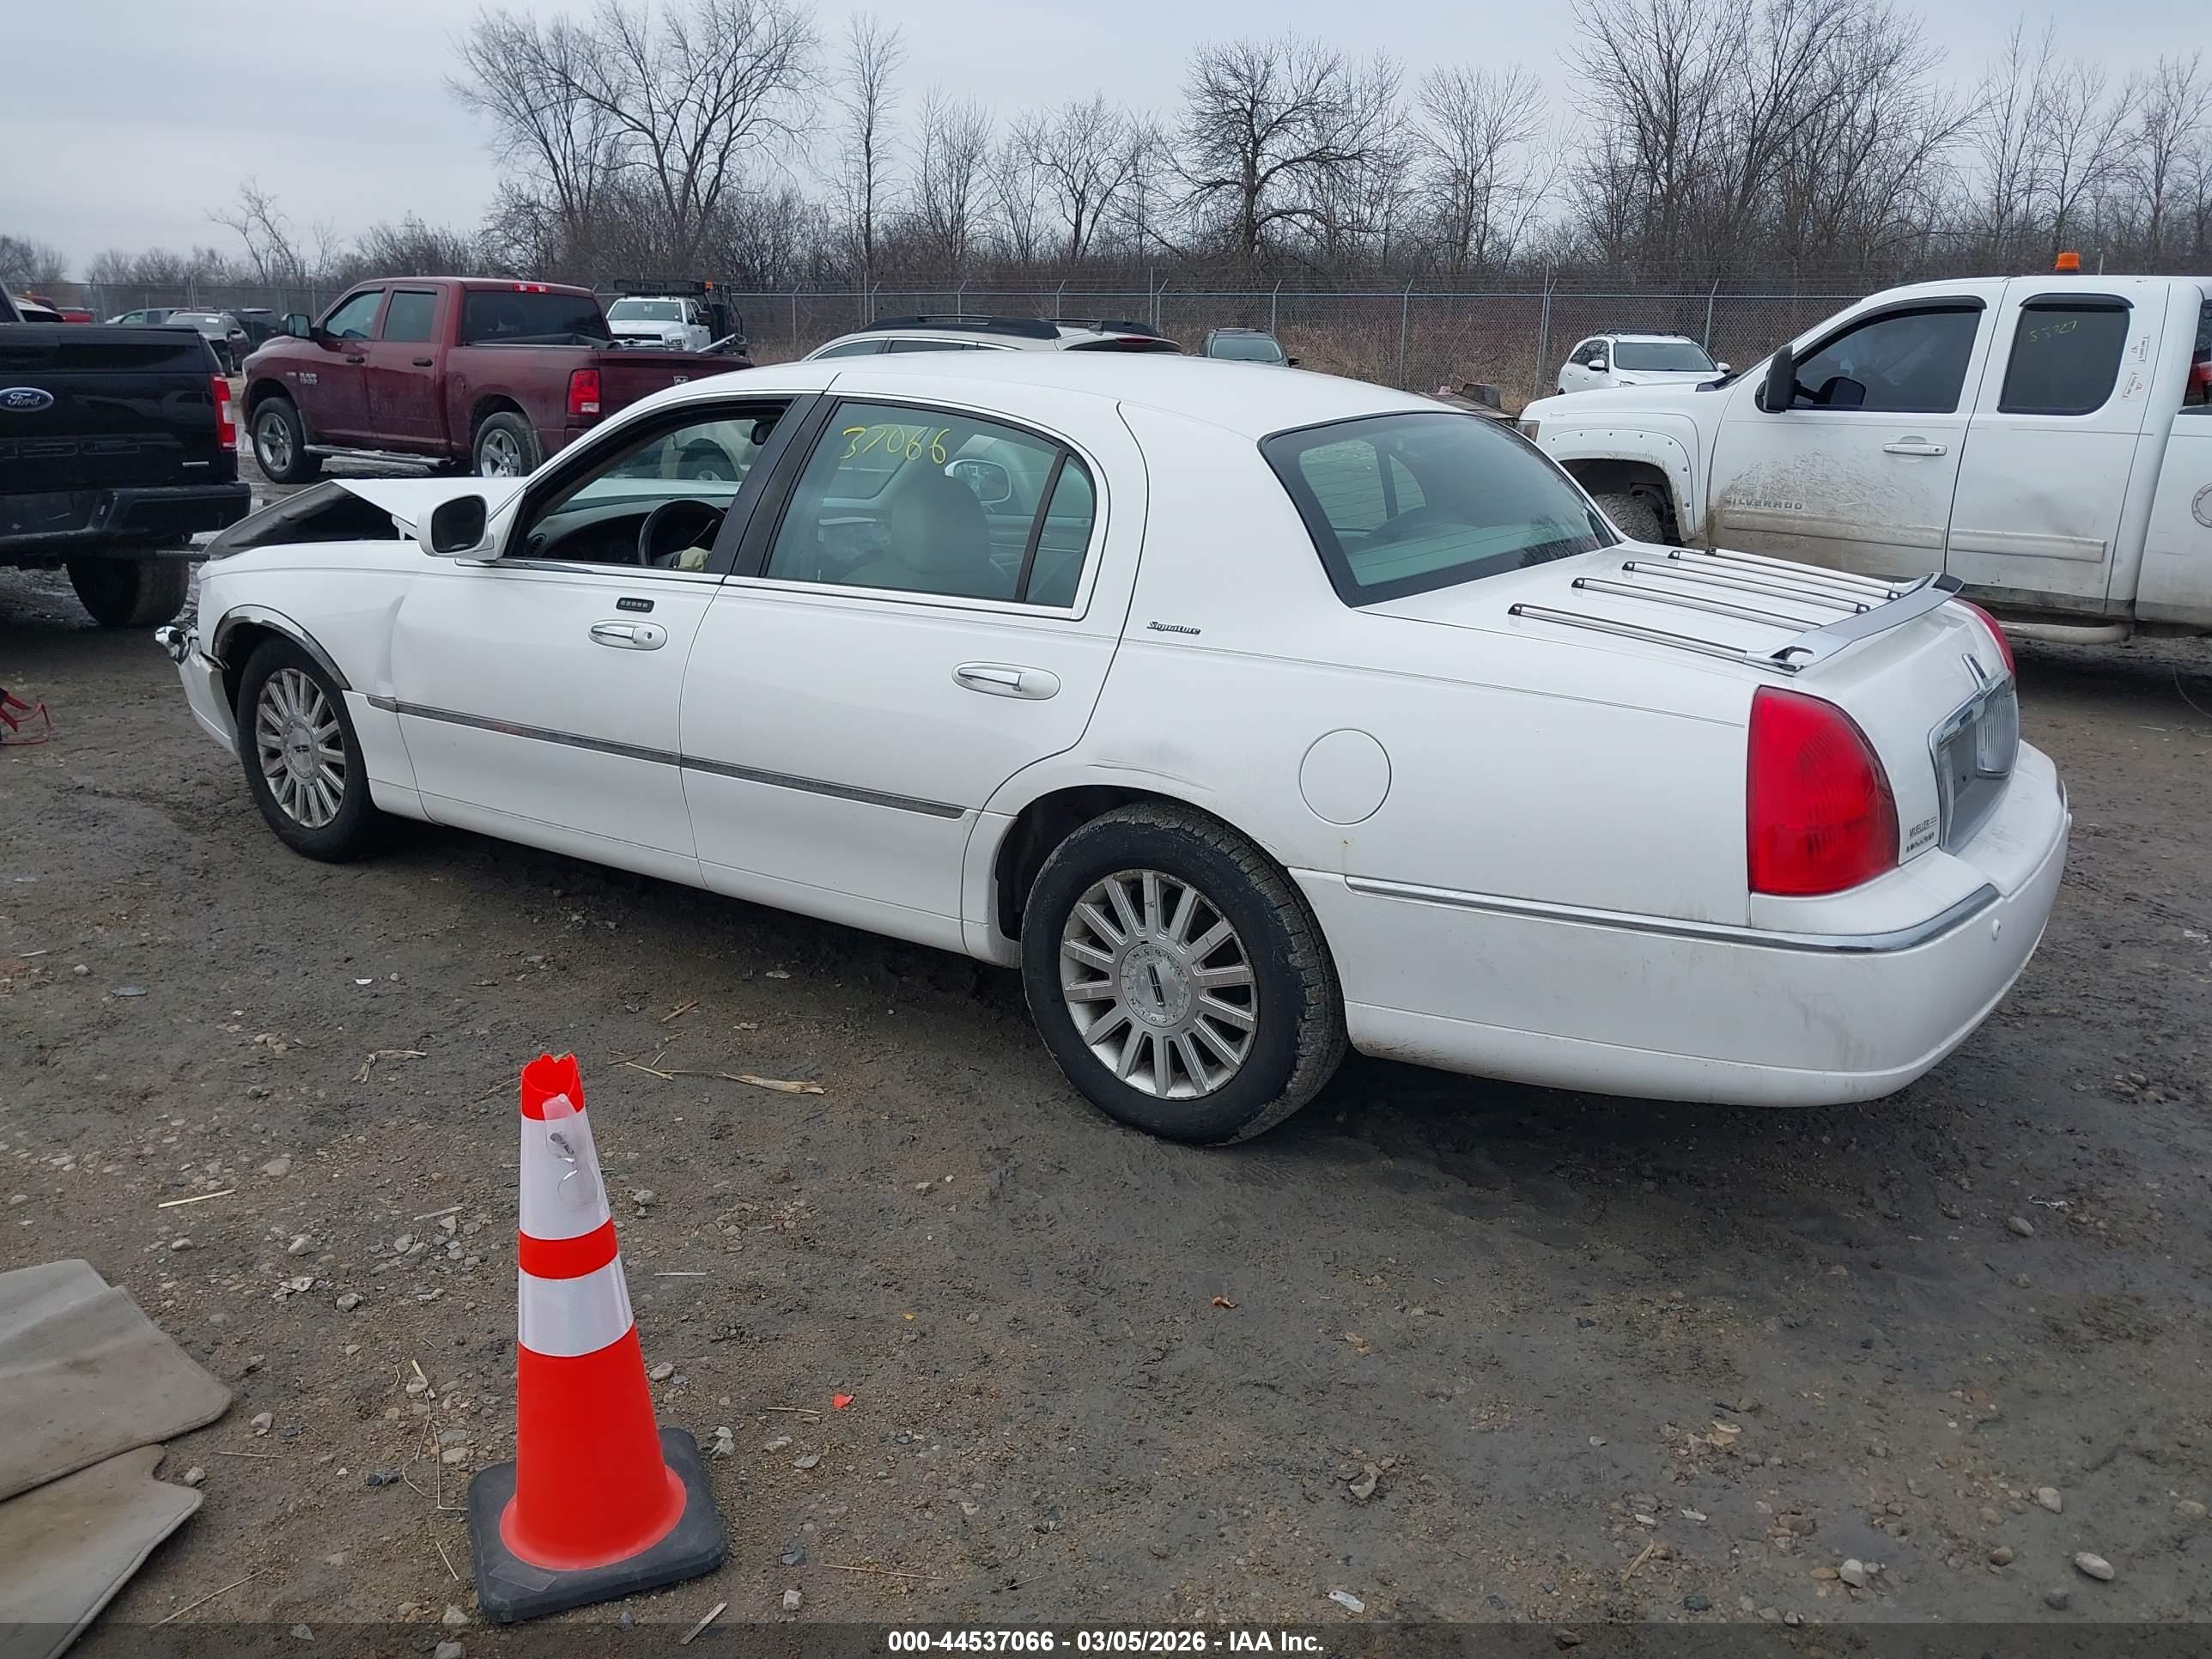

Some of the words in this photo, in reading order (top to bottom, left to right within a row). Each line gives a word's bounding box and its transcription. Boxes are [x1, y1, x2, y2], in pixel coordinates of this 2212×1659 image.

[8, 392, 41, 406] Ford
[839, 426, 951, 465] 37066
[1723, 495, 1803, 510] SILVERADO
[1146, 621, 1201, 635] Signature
[1909, 818, 1929, 840] MUELLER
